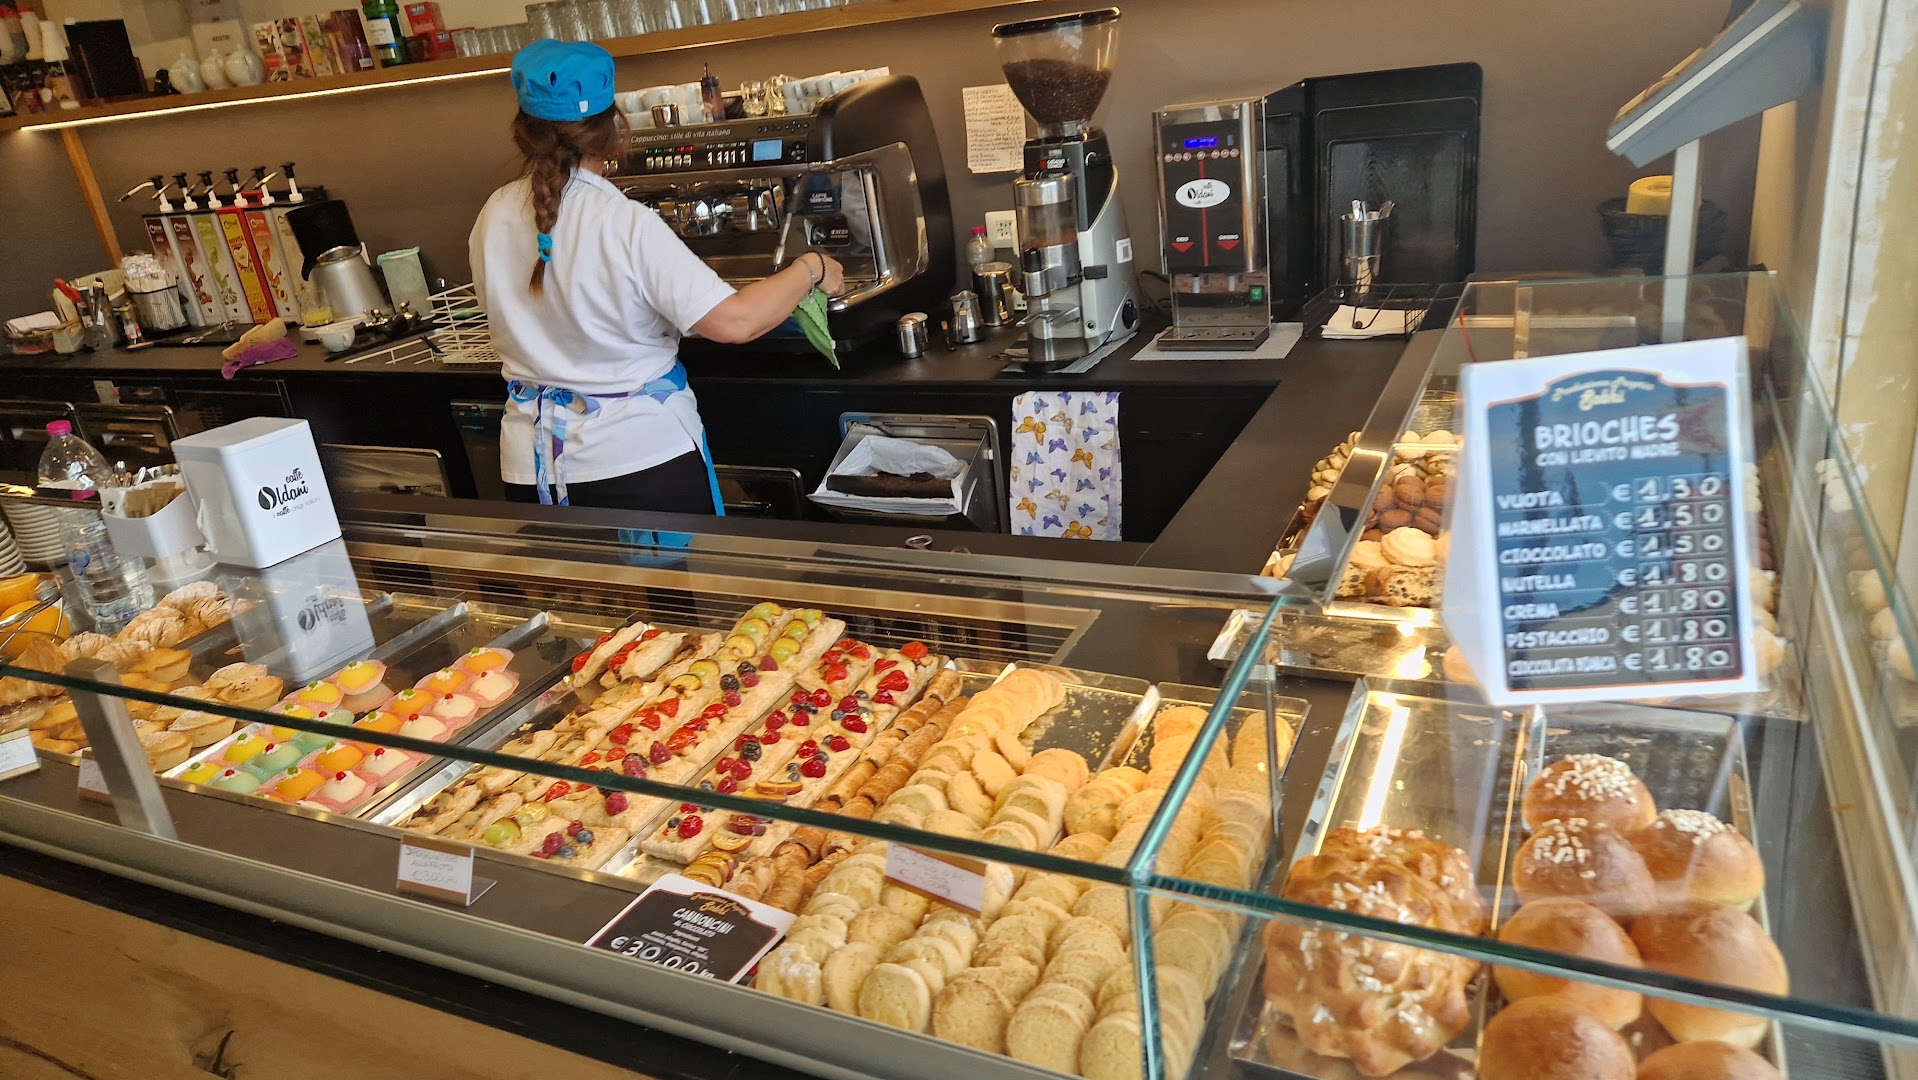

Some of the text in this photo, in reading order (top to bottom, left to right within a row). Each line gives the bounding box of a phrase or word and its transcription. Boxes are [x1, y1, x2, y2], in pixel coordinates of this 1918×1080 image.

[630, 129, 731, 144] Cappuccino: stile di vita italiano
[1535, 413, 1680, 450] BRIOCHES
[1536, 451, 1568, 467] CON
[1569, 446, 1629, 464] LIEVITO
[1497, 490, 1564, 510] VUOTA
[1498, 514, 1604, 537] MARMELLATA
[1500, 542, 1607, 565] CIOCCOLATO
[1502, 574, 1576, 593] NUTELLA
[1504, 602, 1560, 621] CREMA
[1506, 627, 1610, 648] PISTACCHIO
[672, 908, 736, 935] CANNONCINI
[610, 936, 630, 950] €
